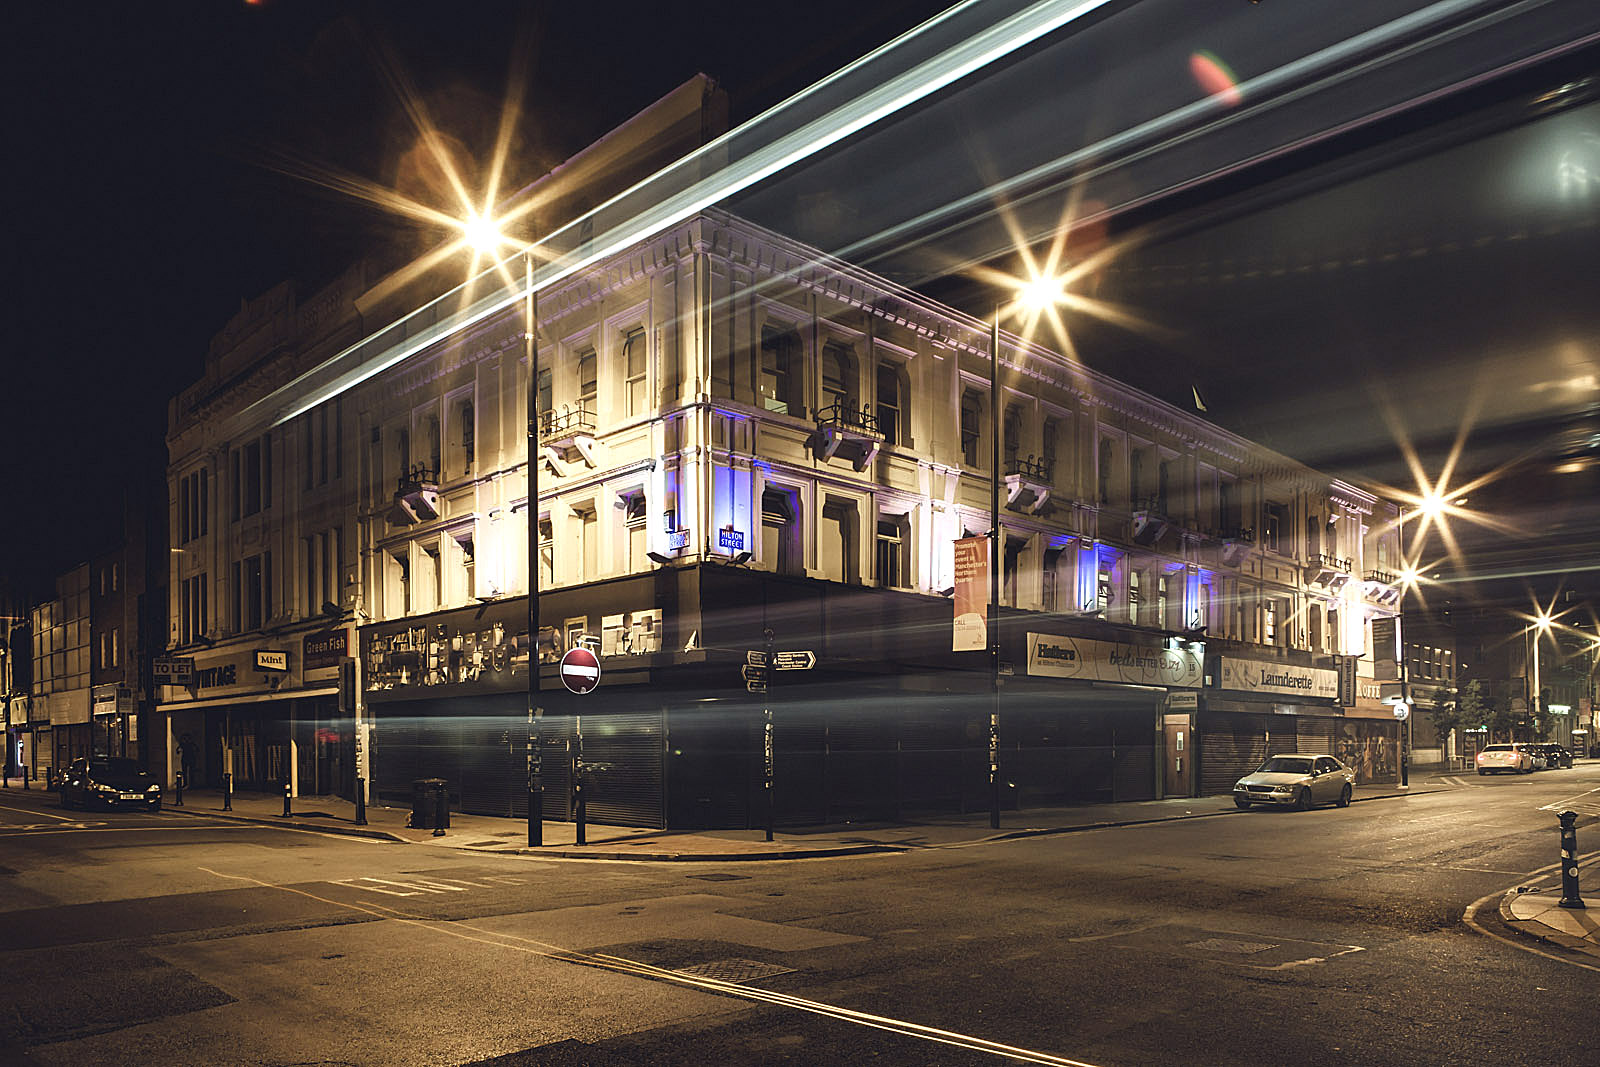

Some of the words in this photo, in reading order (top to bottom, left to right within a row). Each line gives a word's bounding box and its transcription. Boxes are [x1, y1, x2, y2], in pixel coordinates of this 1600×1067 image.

[720, 530, 743, 541] HILTON
[720, 538, 743, 548] STREET
[307, 641, 328, 654] Green
[329, 636, 345, 651] Fish
[261, 655, 283, 665] Mint
[155, 664, 169, 674] TO
[172, 664, 190, 674] LET
[1260, 669, 1313, 690] Launderette
